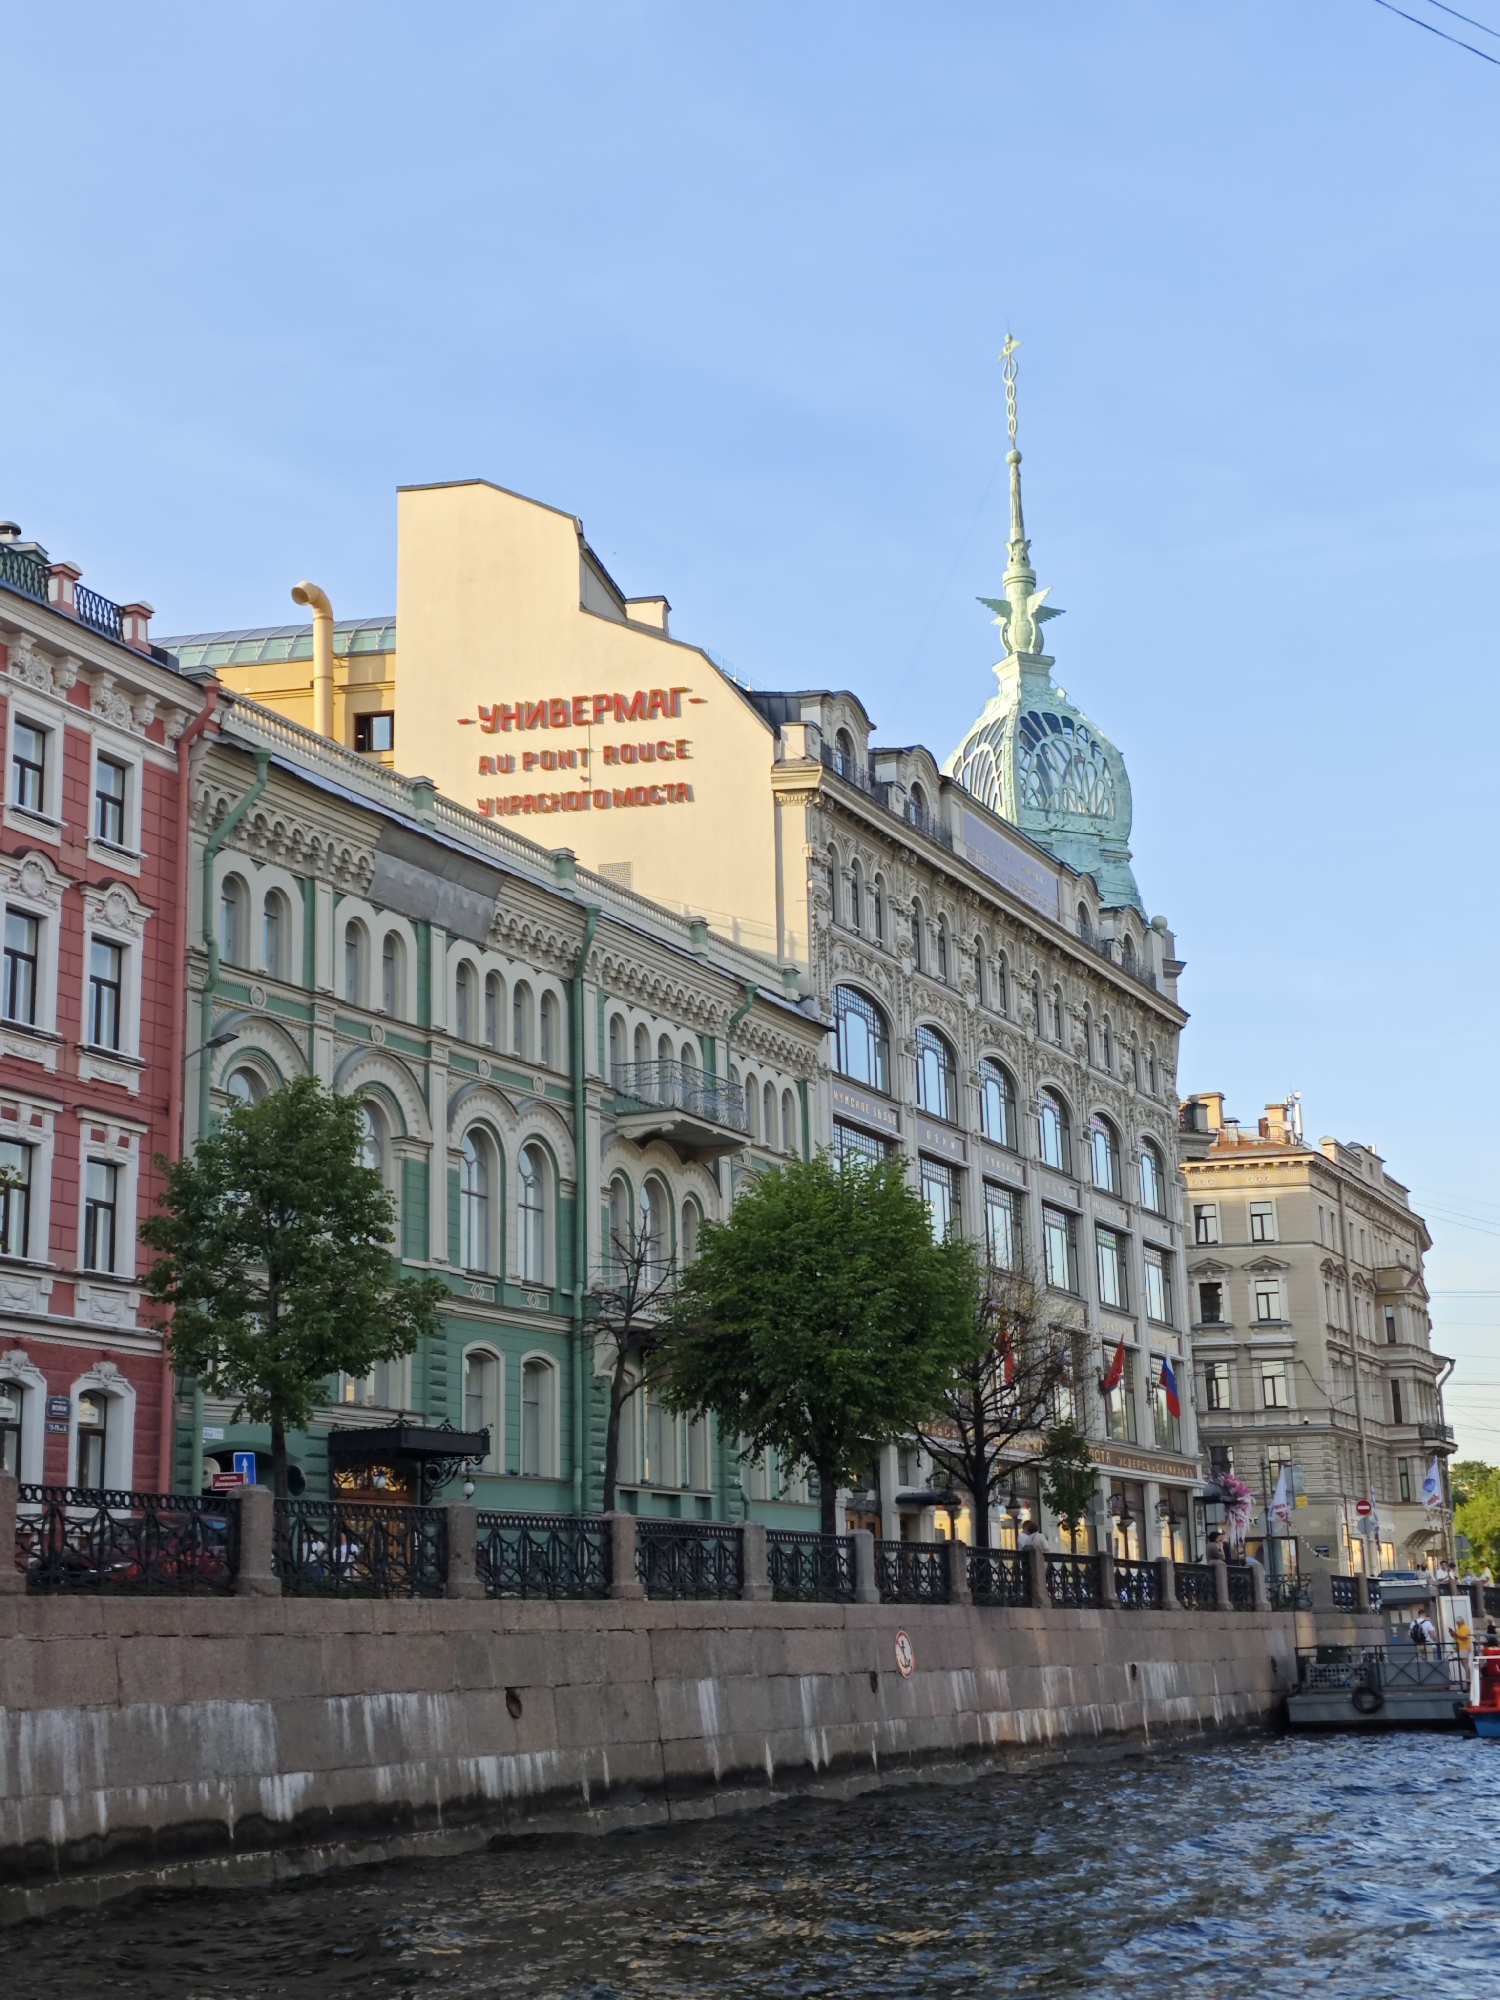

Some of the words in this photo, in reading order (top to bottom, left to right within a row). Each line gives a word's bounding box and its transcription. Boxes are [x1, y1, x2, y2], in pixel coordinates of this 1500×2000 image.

[478, 686, 688, 734] УНИВЕРМАГ
[478, 754, 510, 775] AU
[522, 747, 588, 771] PONT
[603, 739, 688, 765] ROUGE
[612, 782, 689, 807] МОСТА
[833, 1090, 870, 1114] МУЖСКОЕ
[1088, 1448, 1111, 1464] ОСТА
